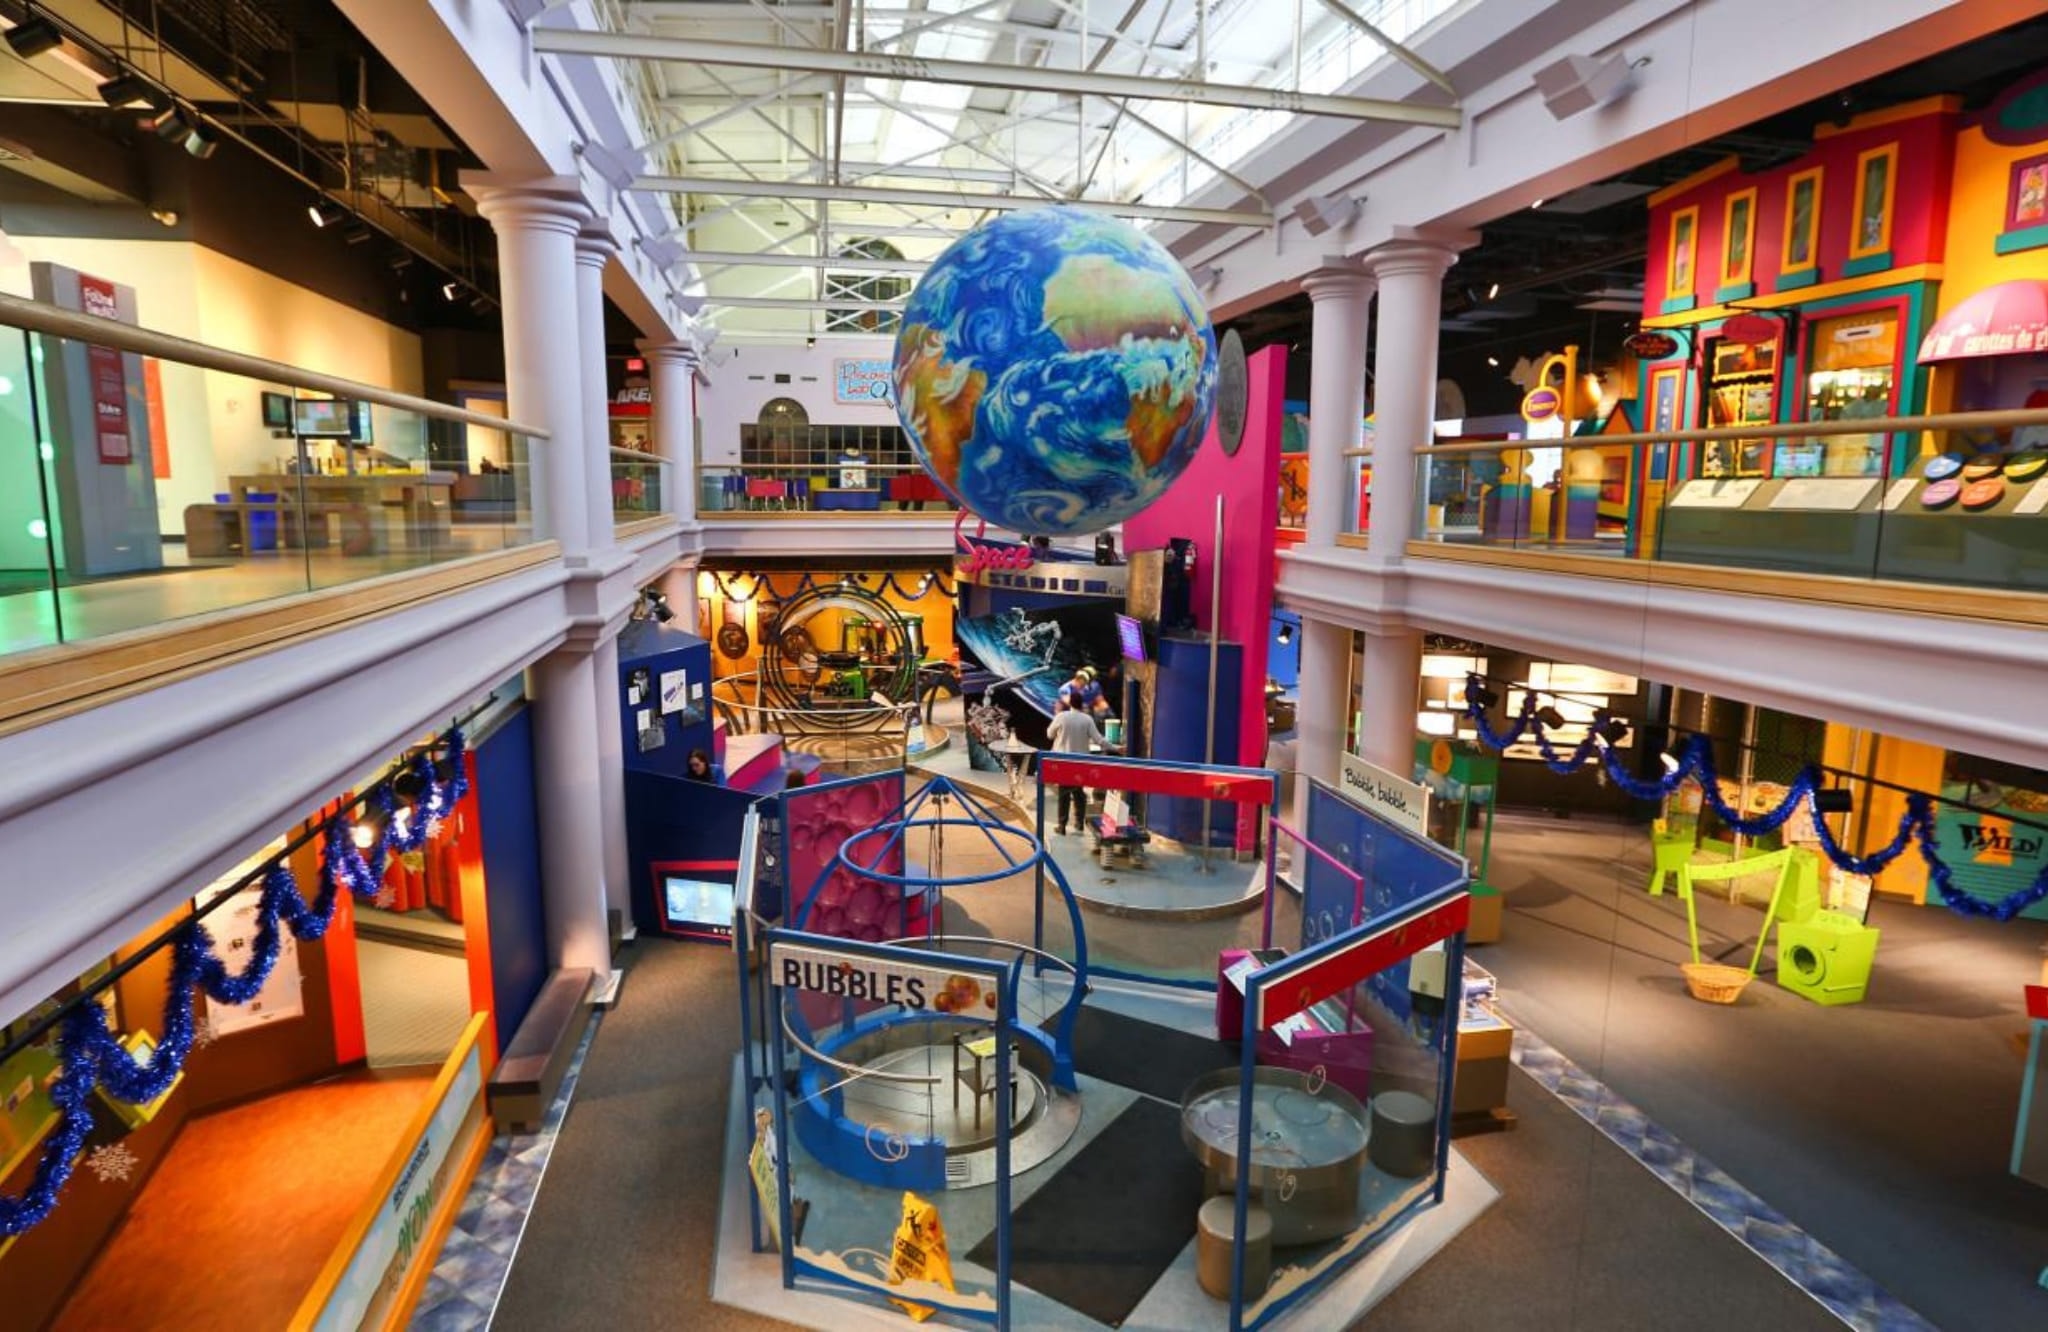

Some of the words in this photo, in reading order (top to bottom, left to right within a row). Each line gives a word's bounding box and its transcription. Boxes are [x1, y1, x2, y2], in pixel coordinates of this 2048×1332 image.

[617, 388, 652, 403] ARE
[955, 518, 1034, 584] Space
[783, 958, 926, 1013] BUBBLES
